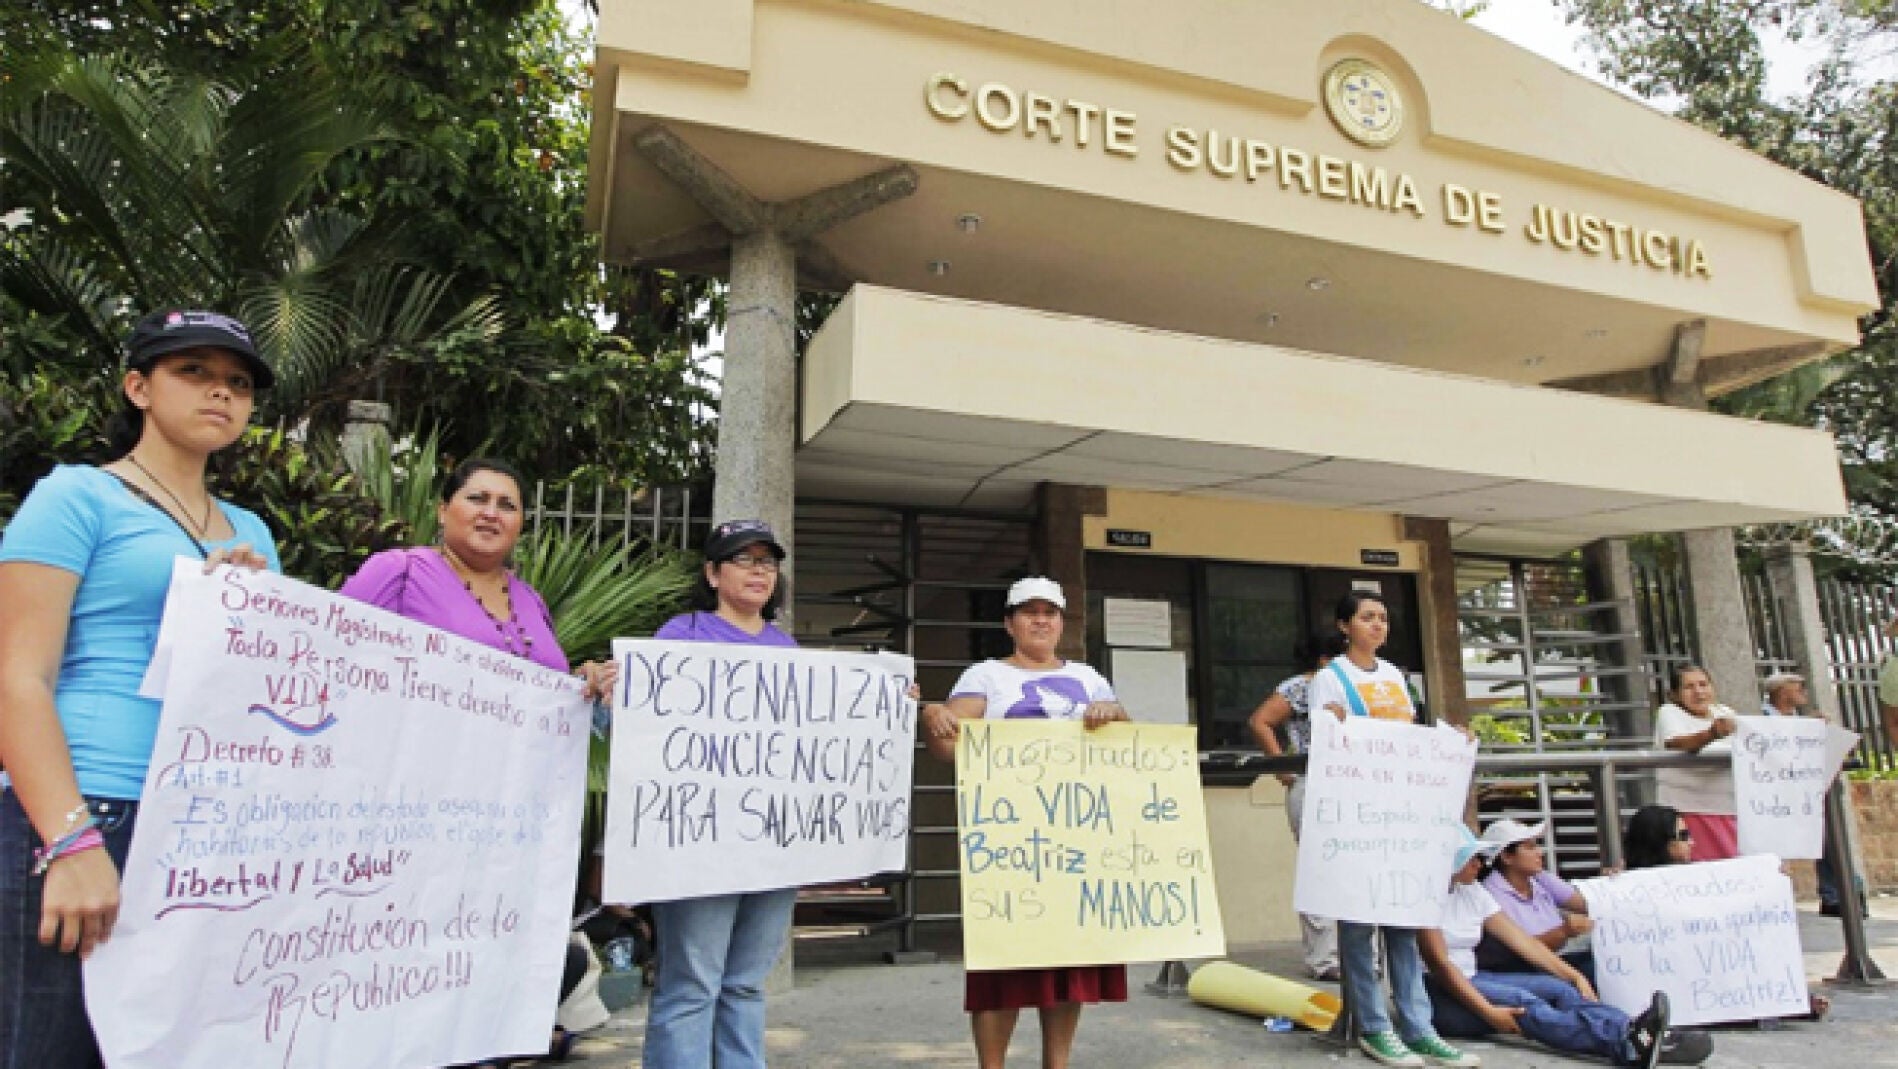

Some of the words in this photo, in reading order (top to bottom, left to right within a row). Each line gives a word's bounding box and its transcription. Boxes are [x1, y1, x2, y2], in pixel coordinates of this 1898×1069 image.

[925, 71, 1138, 158] CORTE
[1166, 127, 1423, 218] SUPREMA
[1443, 182, 1504, 233] DE
[1525, 203, 1713, 278] JUSTICIA
[221, 569, 319, 626] Señores
[426, 633, 447, 656] NO
[394, 656, 453, 708] Tiene
[538, 714, 550, 734] a
[556, 706, 571, 736] la
[621, 651, 910, 734] DESPENALIZAR
[662, 726, 899, 795] CONCIENCIAS
[631, 779, 719, 848] PARA
[737, 787, 848, 848] SALVAR
[1035, 781, 1114, 836] VIDA
[1141, 782, 1181, 824] de
[1316, 797, 1342, 825] El
[961, 827, 1087, 883] Beatriz
[1176, 846, 1206, 874] en
[444, 893, 481, 942] de
[1078, 876, 1202, 936] MANOS!
[1649, 947, 1676, 976] la
[1695, 936, 1759, 976] VIDA
